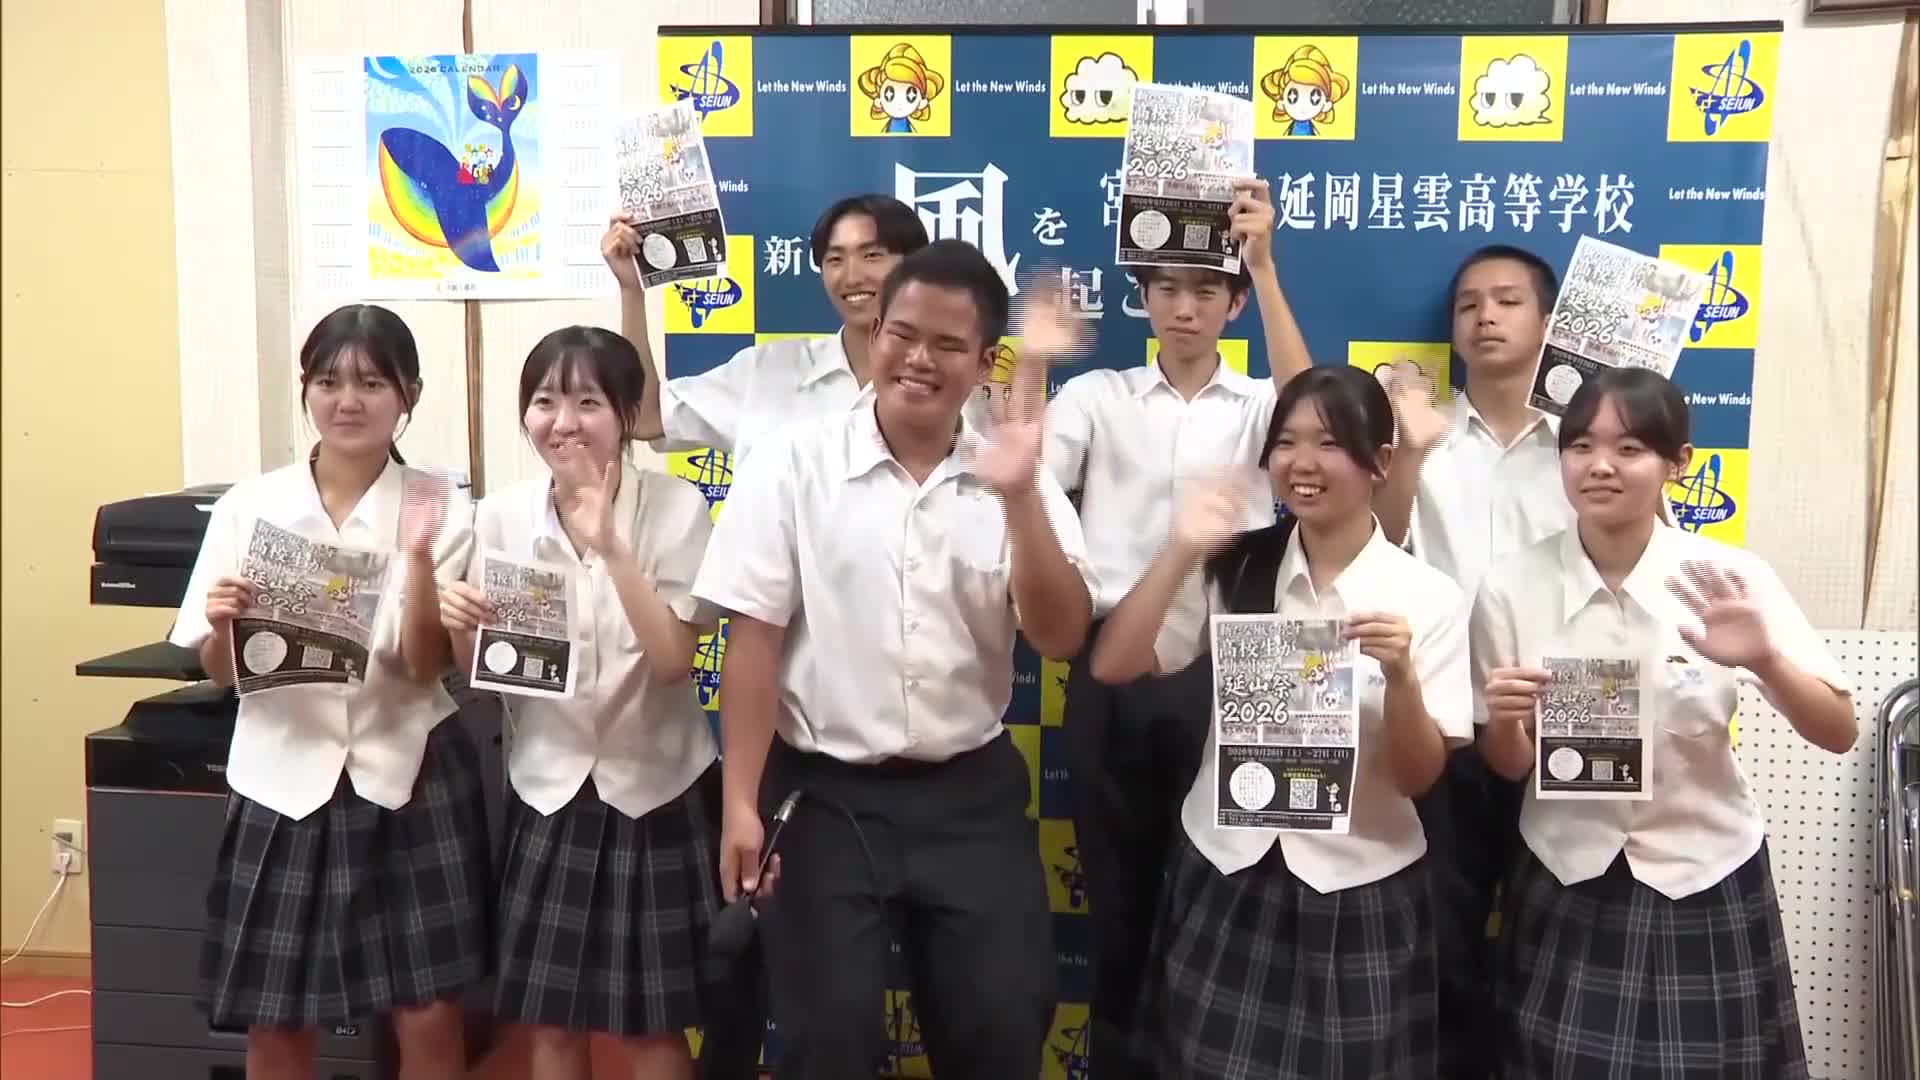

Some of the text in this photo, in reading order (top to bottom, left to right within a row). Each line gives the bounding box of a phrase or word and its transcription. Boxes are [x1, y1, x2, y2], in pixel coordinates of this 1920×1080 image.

[757, 80, 846, 93] Let the New Winds
[955, 80, 1046, 93] Let the New Winds
[1217, 80, 1249, 94] Winds
[1362, 82, 1456, 95] Let the New Winds
[1569, 82, 1667, 96] Let the New Winds
[699, 95, 732, 108] SEIUN
[1718, 97, 1755, 110] SEIUN
[1133, 134, 1198, 161] 延山祭
[1128, 157, 1189, 180] 2026
[718, 180, 749, 193] Winds
[1668, 187, 1765, 200] Let the New Winds
[622, 184, 664, 208] 2026
[1277, 170, 1636, 234] 延岡星雲高等学校
[1032, 207, 1068, 246] を
[703, 292, 735, 305] SEIUN
[1703, 305, 1740, 319] SEIUN
[1556, 310, 1616, 345] 2026
[1692, 392, 1717, 405] New
[1719, 392, 1751, 405] Winds
[706, 485, 727, 497] SEIU
[1692, 507, 1728, 520] SEIUN
[257, 592, 306, 616] 026
[496, 607, 528, 622] 026
[1222, 671, 1297, 700] 延山祭
[1222, 700, 1290, 725] 2026
[1543, 707, 1592, 724] 2026
